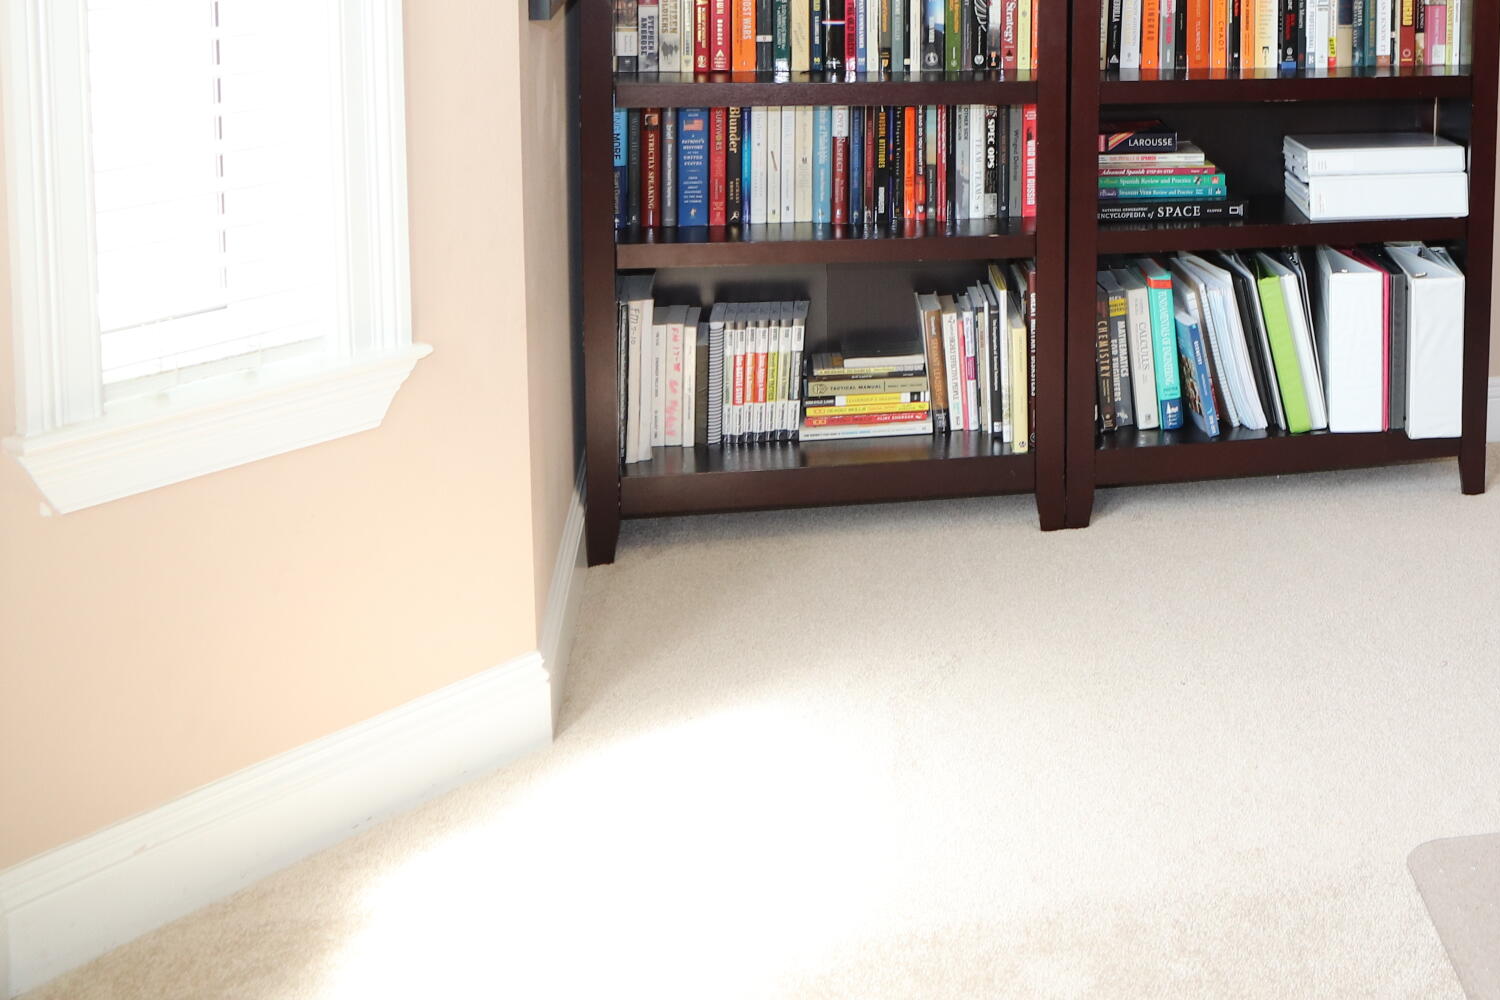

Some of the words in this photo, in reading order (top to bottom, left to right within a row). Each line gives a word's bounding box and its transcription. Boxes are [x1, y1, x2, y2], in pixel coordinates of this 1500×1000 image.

[743, 18, 752, 40] WARS
[1004, 2, 1014, 43] Strategy
[730, 106, 740, 153] Blunder
[1128, 138, 1172, 149] LAROUSSE
[1097, 211, 1146, 219] ENCYCLOPEDIA
[1148, 210, 1154, 218] of
[1158, 206, 1200, 217] SPACE
[1098, 320, 1110, 377] CHEMISTRY
[1118, 321, 1128, 377] MATHEMATICS
[1139, 322, 1150, 370] CALCULUS
[950, 354, 958, 380] EFFECTIVE
